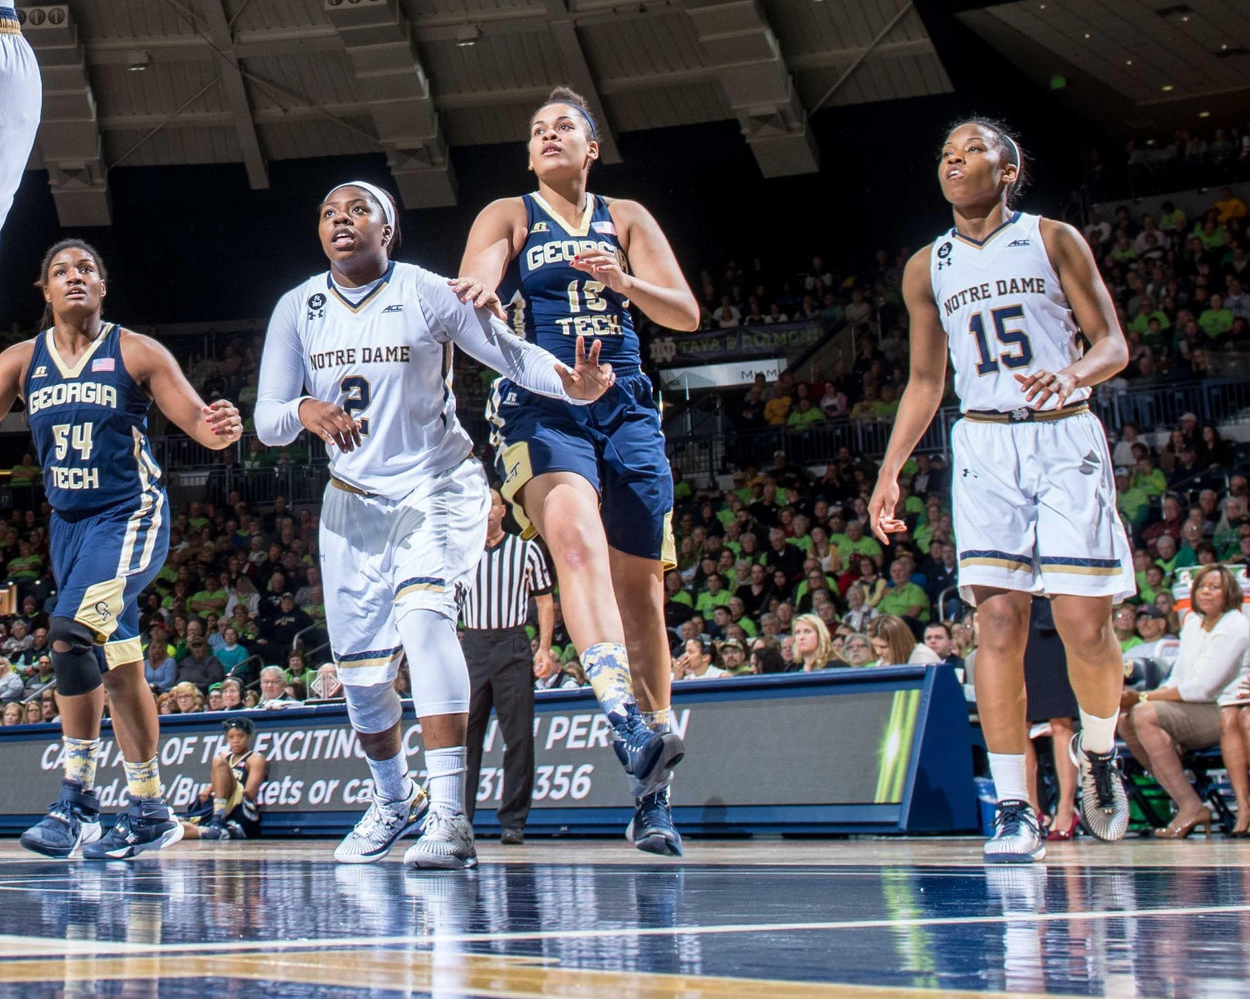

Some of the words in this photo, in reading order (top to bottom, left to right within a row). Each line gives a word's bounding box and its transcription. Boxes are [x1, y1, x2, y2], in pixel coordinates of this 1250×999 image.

[943, 282, 992, 317] NOTRE
[995, 277, 1046, 297] DAME
[555, 315, 623, 336] TECH
[968, 303, 1035, 378] 15
[310, 348, 356, 371] NOTRE
[361, 345, 411, 364] DAME
[29, 382, 117, 415] GEORGIA
[340, 374, 371, 437] 2
[52, 422, 94, 460] 54
[50, 467, 100, 490] TECH
[161, 735, 198, 766] OF
[308, 778, 340, 805] or
